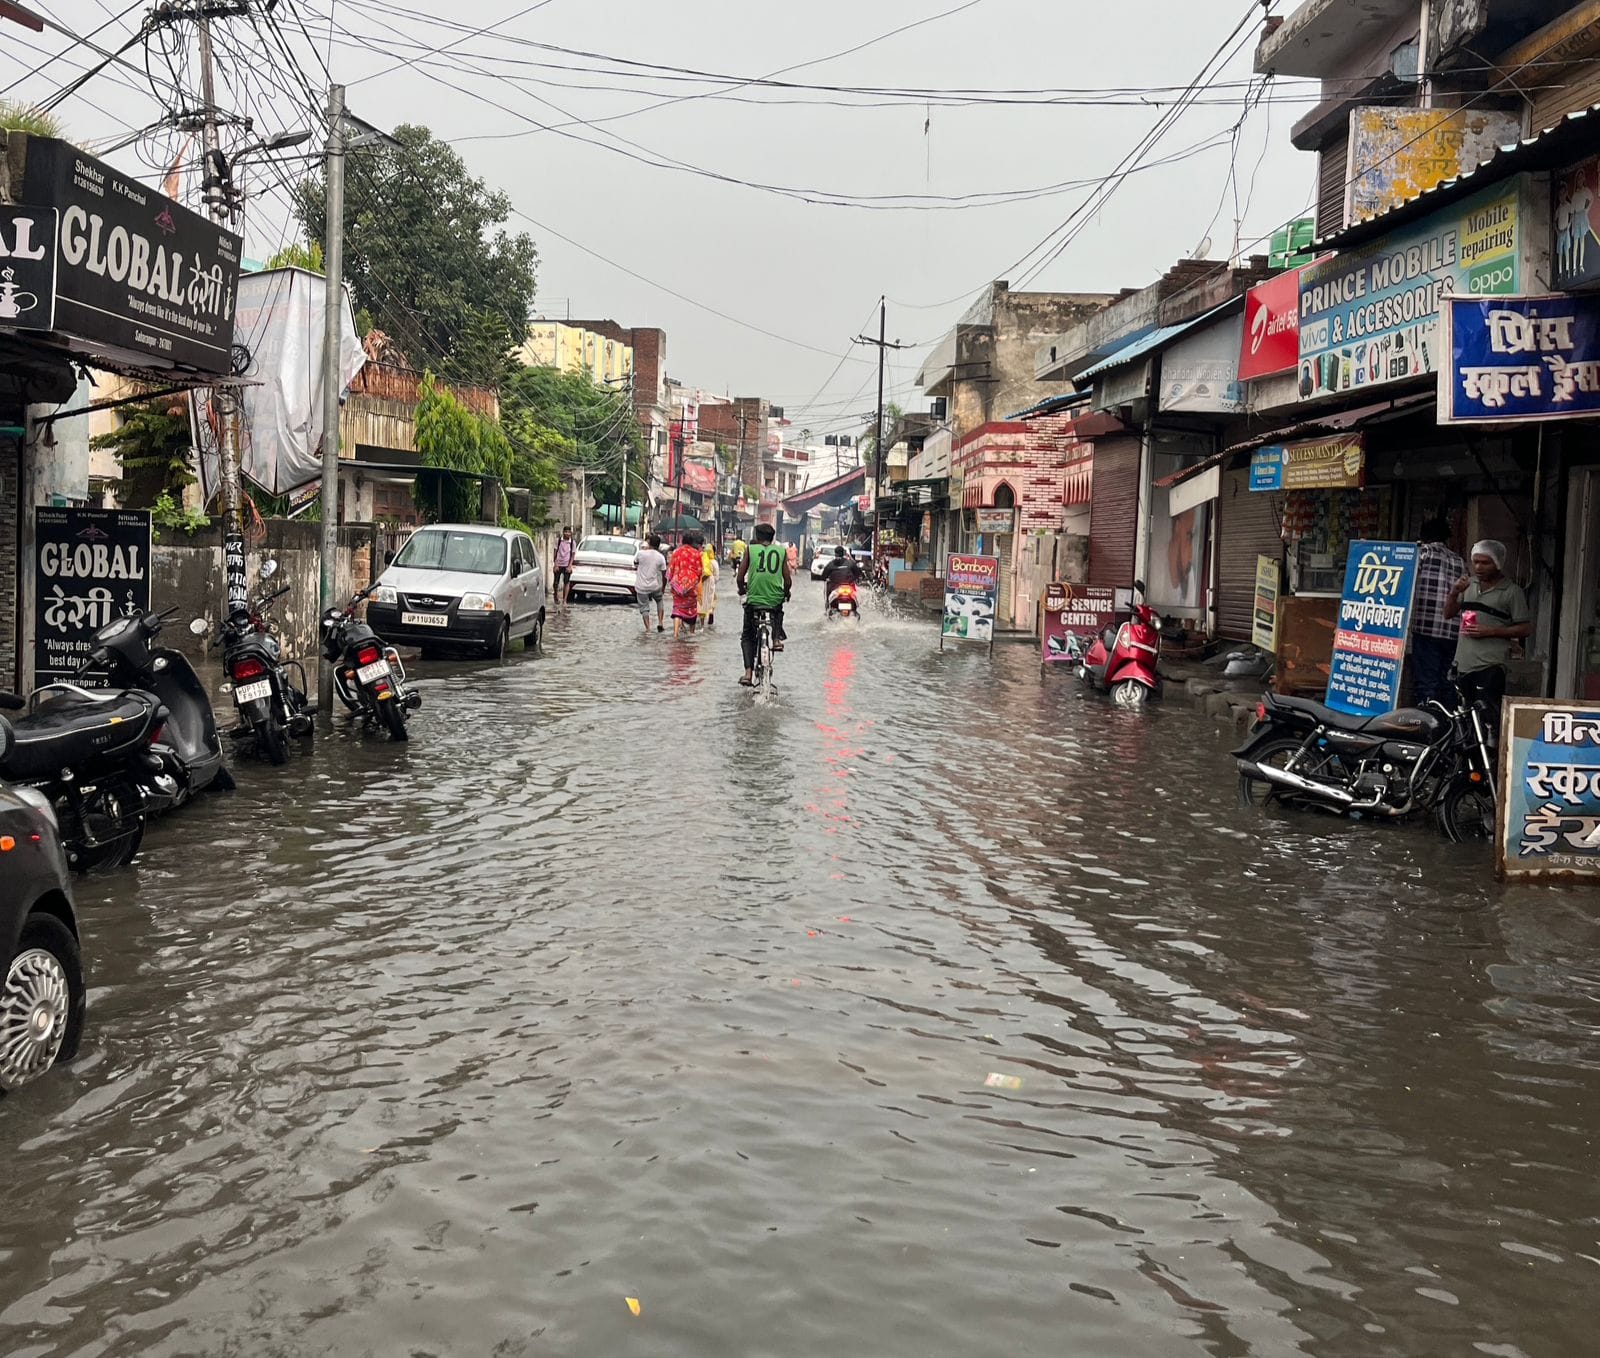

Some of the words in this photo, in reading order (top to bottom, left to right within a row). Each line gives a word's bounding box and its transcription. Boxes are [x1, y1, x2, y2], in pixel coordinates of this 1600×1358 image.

[75, 159, 105, 185] Shekhar
[1467, 204, 1509, 236] Mobile
[61, 205, 185, 306] GLOBAL
[1461, 225, 1513, 260] repairing
[1301, 268, 1367, 319] PRINCE
[1371, 230, 1457, 293] MOBILE
[1470, 266, 1513, 294] oppo
[1332, 315, 1344, 345] &
[1346, 275, 1455, 340] ACCESSORIES
[1267, 312, 1286, 336] airtel
[1301, 324, 1327, 349] vivo
[1460, 365, 1541, 407] स्कूल
[1289, 446, 1315, 462] SUCCESS
[41, 542, 144, 580] GLOBAL
[757, 550, 781, 573] 10
[952, 557, 994, 574] Bombay
[1071, 598, 1113, 612] SERVICE
[1060, 612, 1097, 626] CENTER
[75, 639, 92, 651] dres
[49, 655, 66, 666] best
[67, 655, 81, 669] day
[1526, 762, 1600, 804] स्कू
